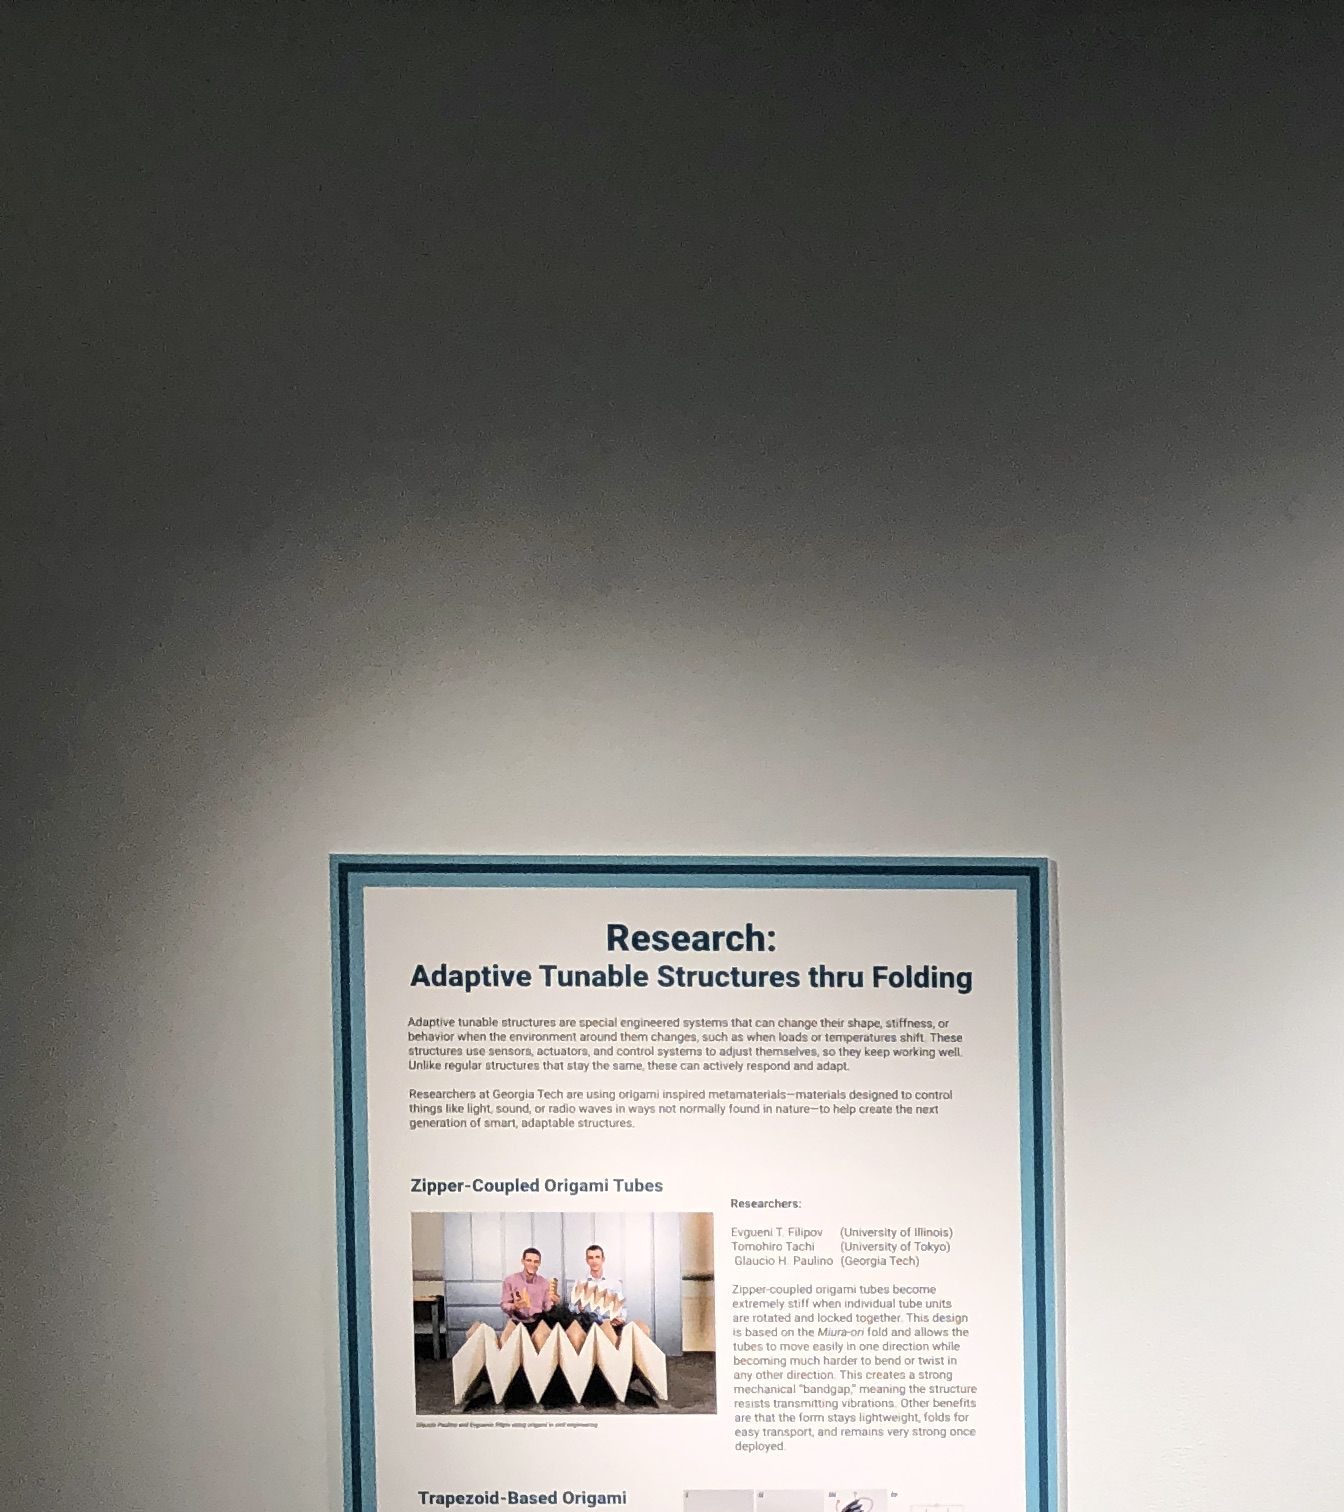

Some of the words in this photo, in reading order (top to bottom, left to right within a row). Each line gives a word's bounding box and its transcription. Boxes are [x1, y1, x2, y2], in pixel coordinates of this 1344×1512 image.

[607, 922, 775, 952] Research:
[410, 963, 532, 993] Adaptive
[538, 963, 648, 987] Tunable
[656, 964, 800, 987] Structures
[807, 963, 863, 987] thru
[872, 963, 972, 993] Folding
[407, 1017, 455, 1029] Adaptive
[457, 1017, 498, 1027] tunable
[501, 1018, 556, 1027] structures
[558, 1019, 576, 1027] are
[578, 1017, 617, 1029] special
[619, 1017, 680, 1030] engineered
[682, 1018, 728, 1030] systems
[730, 1017, 752, 1027] that
[777, 1017, 818, 1030] change
[819, 1017, 844, 1027] their
[847, 1017, 883, 1030] shape,
[410, 1177, 539, 1195] Zipper-Coupled
[544, 1177, 608, 1196] Origami
[612, 1177, 663, 1192] Tubes
[730, 1198, 801, 1208] Researchers:
[731, 1227, 773, 1239] Evgueni
[787, 1226, 823, 1239] Filipov
[839, 1226, 897, 1239] (University
[899, 1226, 911, 1237] of
[914, 1226, 953, 1239] Illinois)
[730, 1241, 782, 1251] Tomohiro
[785, 1241, 814, 1251] Tachi
[840, 1240, 897, 1254] (University
[899, 1241, 911, 1251] of
[913, 1240, 950, 1254] Tokyo)
[734, 1255, 775, 1265] Glaucio
[793, 1255, 833, 1265] Paulino
[840, 1255, 886, 1268] (Georgia
[888, 1255, 919, 1268] Tech)
[417, 1489, 557, 1508] Trapezoid-Based
[562, 1490, 626, 1508] Origami
